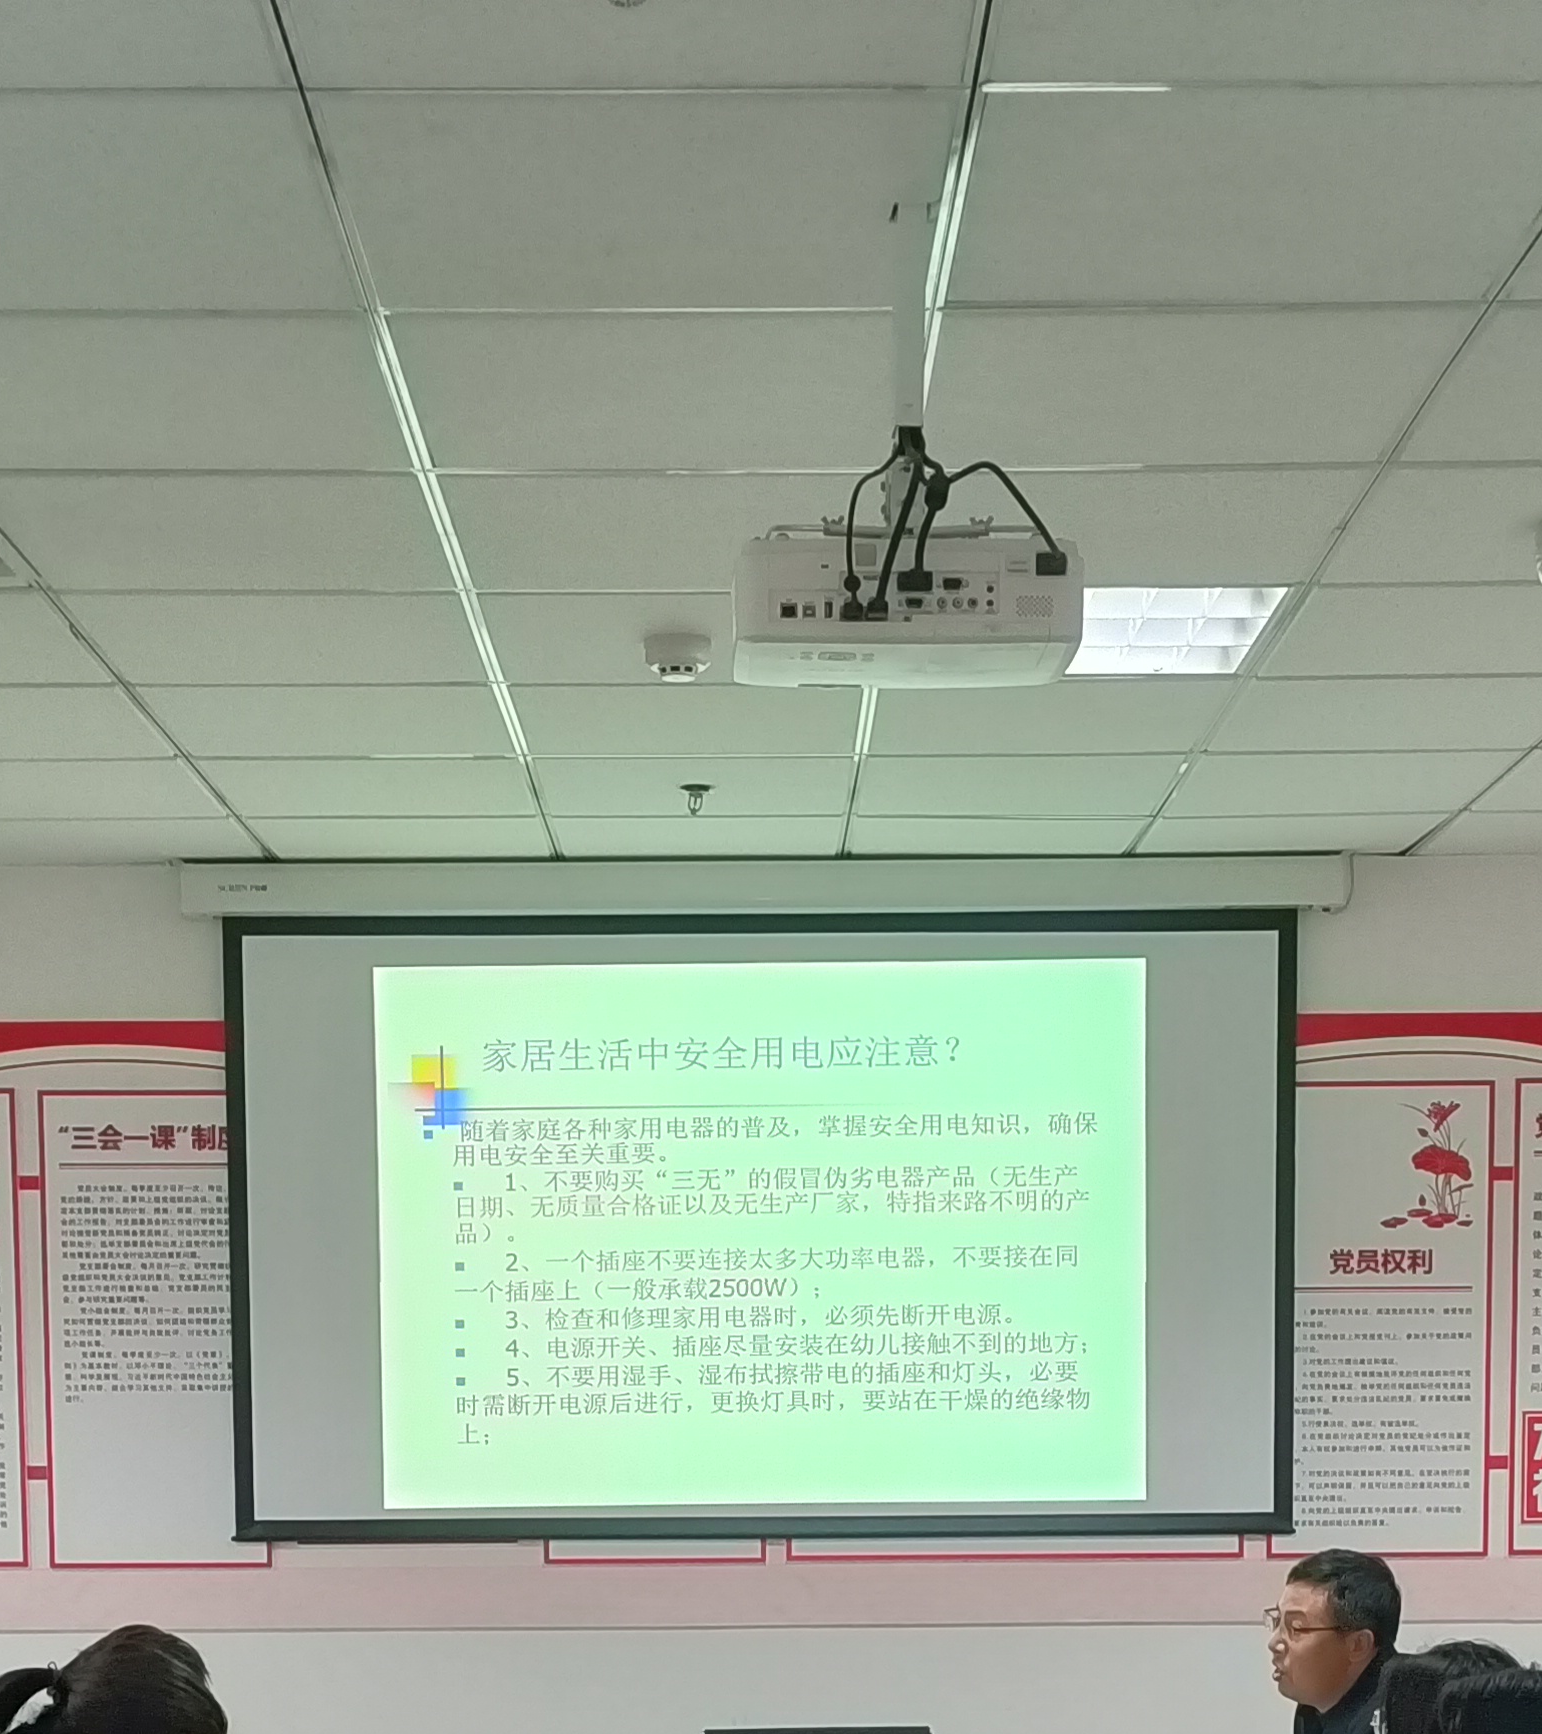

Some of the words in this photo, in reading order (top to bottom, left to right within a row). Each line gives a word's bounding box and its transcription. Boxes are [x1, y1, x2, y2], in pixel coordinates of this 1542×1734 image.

[482, 1034, 960, 1072] 家居生活中安全用电应注意？
[460, 1111, 1098, 1142] 随着家庭各种家用电器的普及，掌握安全用电知识，确保
[453, 1141, 667, 1167] 用电安全至关重要。
[456, 1188, 1090, 1218] 日期、无质量合格证以及无生产厂家，特指来路不明的产
[505, 1244, 1079, 1273] 2、一个插座不要连接太多大功率电器，不要接在同
[1328, 1248, 1434, 1276] 党员权利
[505, 1303, 1014, 1331] 3、检查和修理家用电器时，必须先断开电源。
[506, 1360, 1079, 1388] 5、不要用湿手、湿布拭擦带电的插座和灯头，必要
[456, 1388, 1091, 1416] 时需断开电源后进行，更换灯具时，要站在干燥的绝缘物
